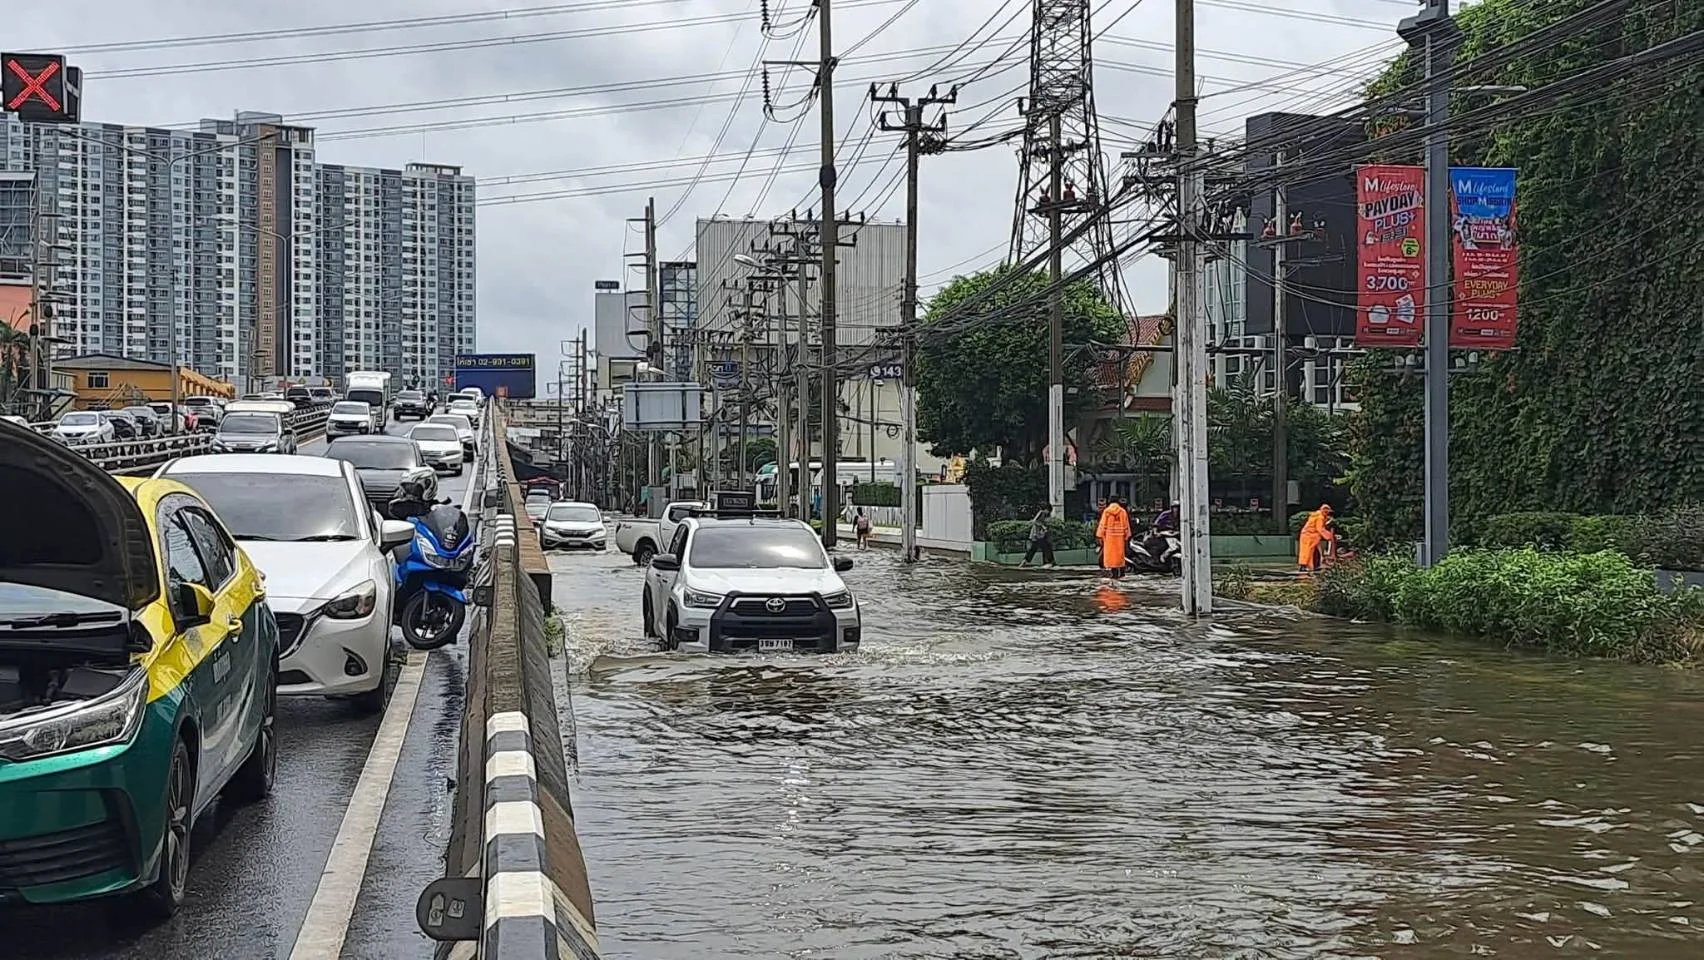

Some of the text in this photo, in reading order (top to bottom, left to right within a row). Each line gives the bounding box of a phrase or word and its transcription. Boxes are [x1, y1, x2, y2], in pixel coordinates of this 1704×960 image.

[1365, 178, 1379, 192] M
[1458, 180, 1472, 194] M
[1365, 190, 1415, 217] PAYDAY
[1366, 275, 1408, 291] 3,700
[1464, 280, 1508, 290] EVERYDAY
